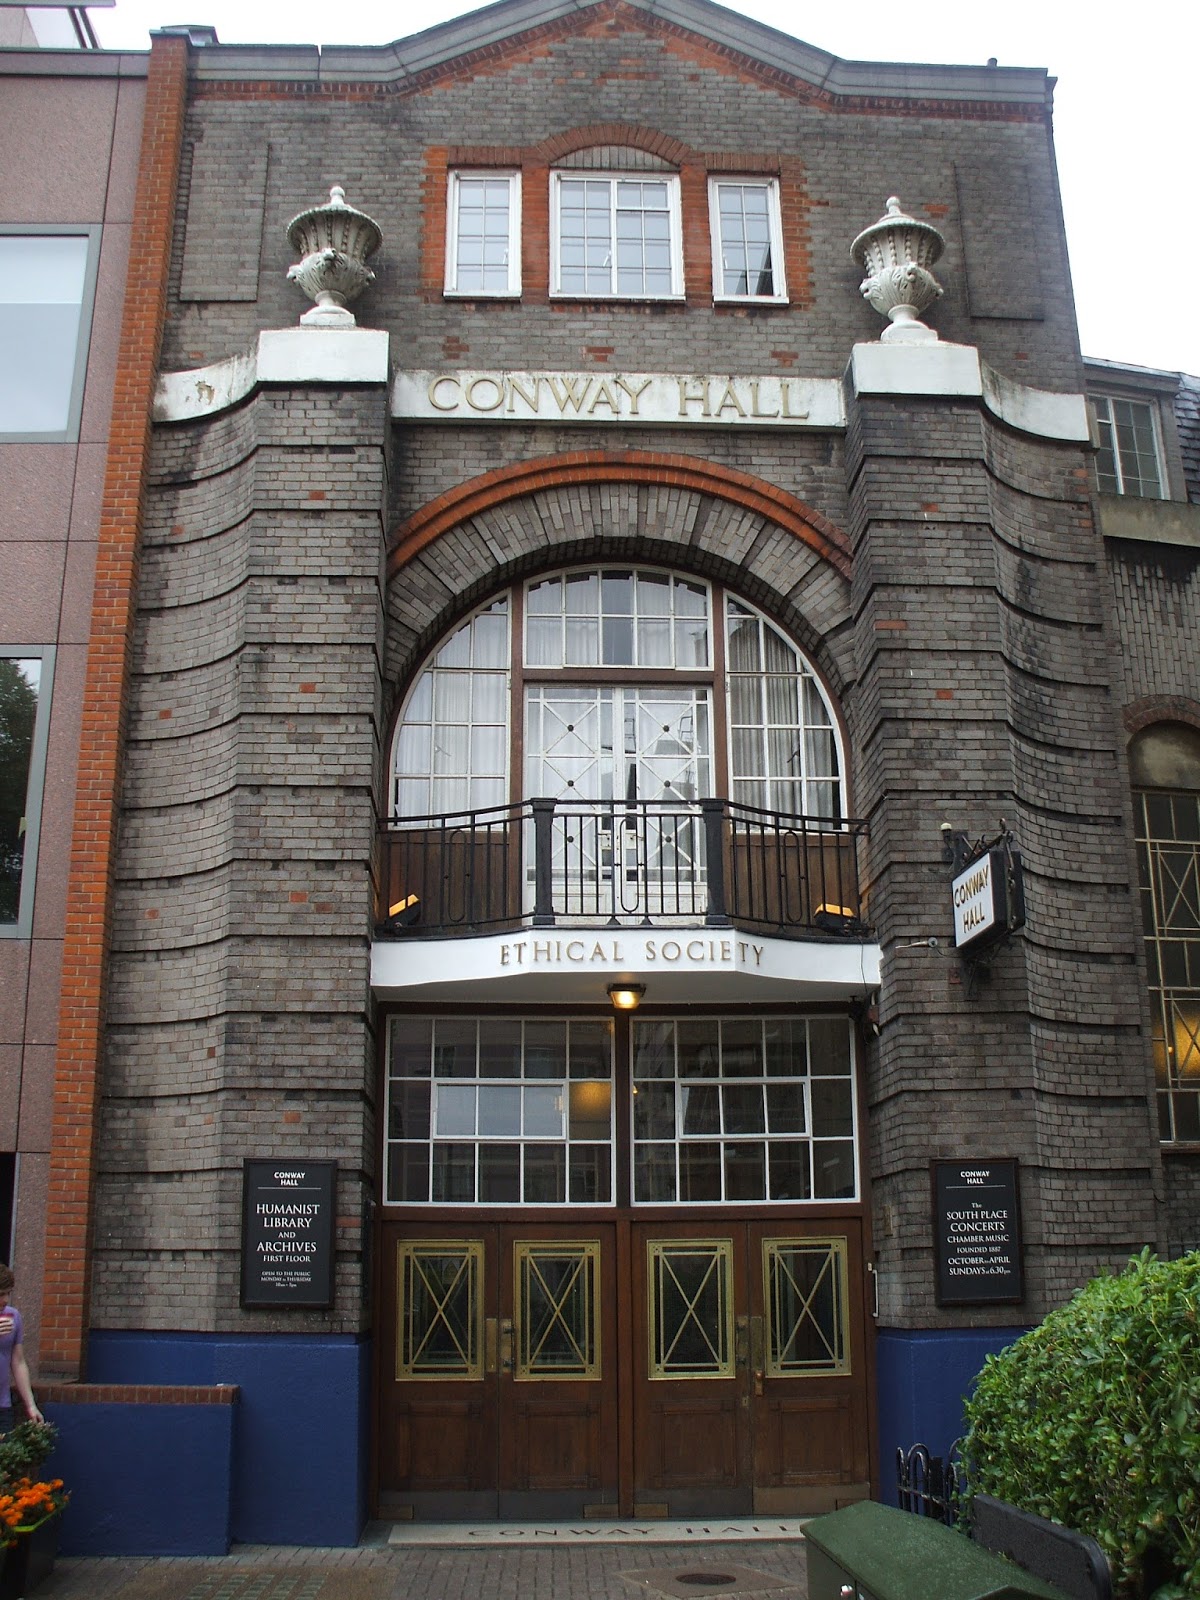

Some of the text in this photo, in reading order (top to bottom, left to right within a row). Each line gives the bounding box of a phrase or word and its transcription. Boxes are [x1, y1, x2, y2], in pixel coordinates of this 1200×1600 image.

[427, 376, 810, 419] CONWAY HALL
[954, 865, 989, 907] CONWAY
[963, 902, 985, 933] HALL
[500, 940, 764, 966] ETHICAL SOCIETY
[274, 1171, 305, 1179] CONWAY
[256, 1203, 320, 1215] HUMANIST
[946, 1210, 1008, 1220] SOUTH PLACE
[263, 1217, 312, 1228] LIBRARY
[950, 1221, 1005, 1232] CONCERTS
[278, 1231, 296, 1239] AND
[947, 1234, 1009, 1243] CHAMBER MUSIC
[256, 1241, 317, 1252] ARCHIVES
[947, 1257, 984, 1265] OCTOBER
[949, 1267, 985, 1275] SUNDAYS
[468, 1525, 799, 1537] CONWAY HALL
